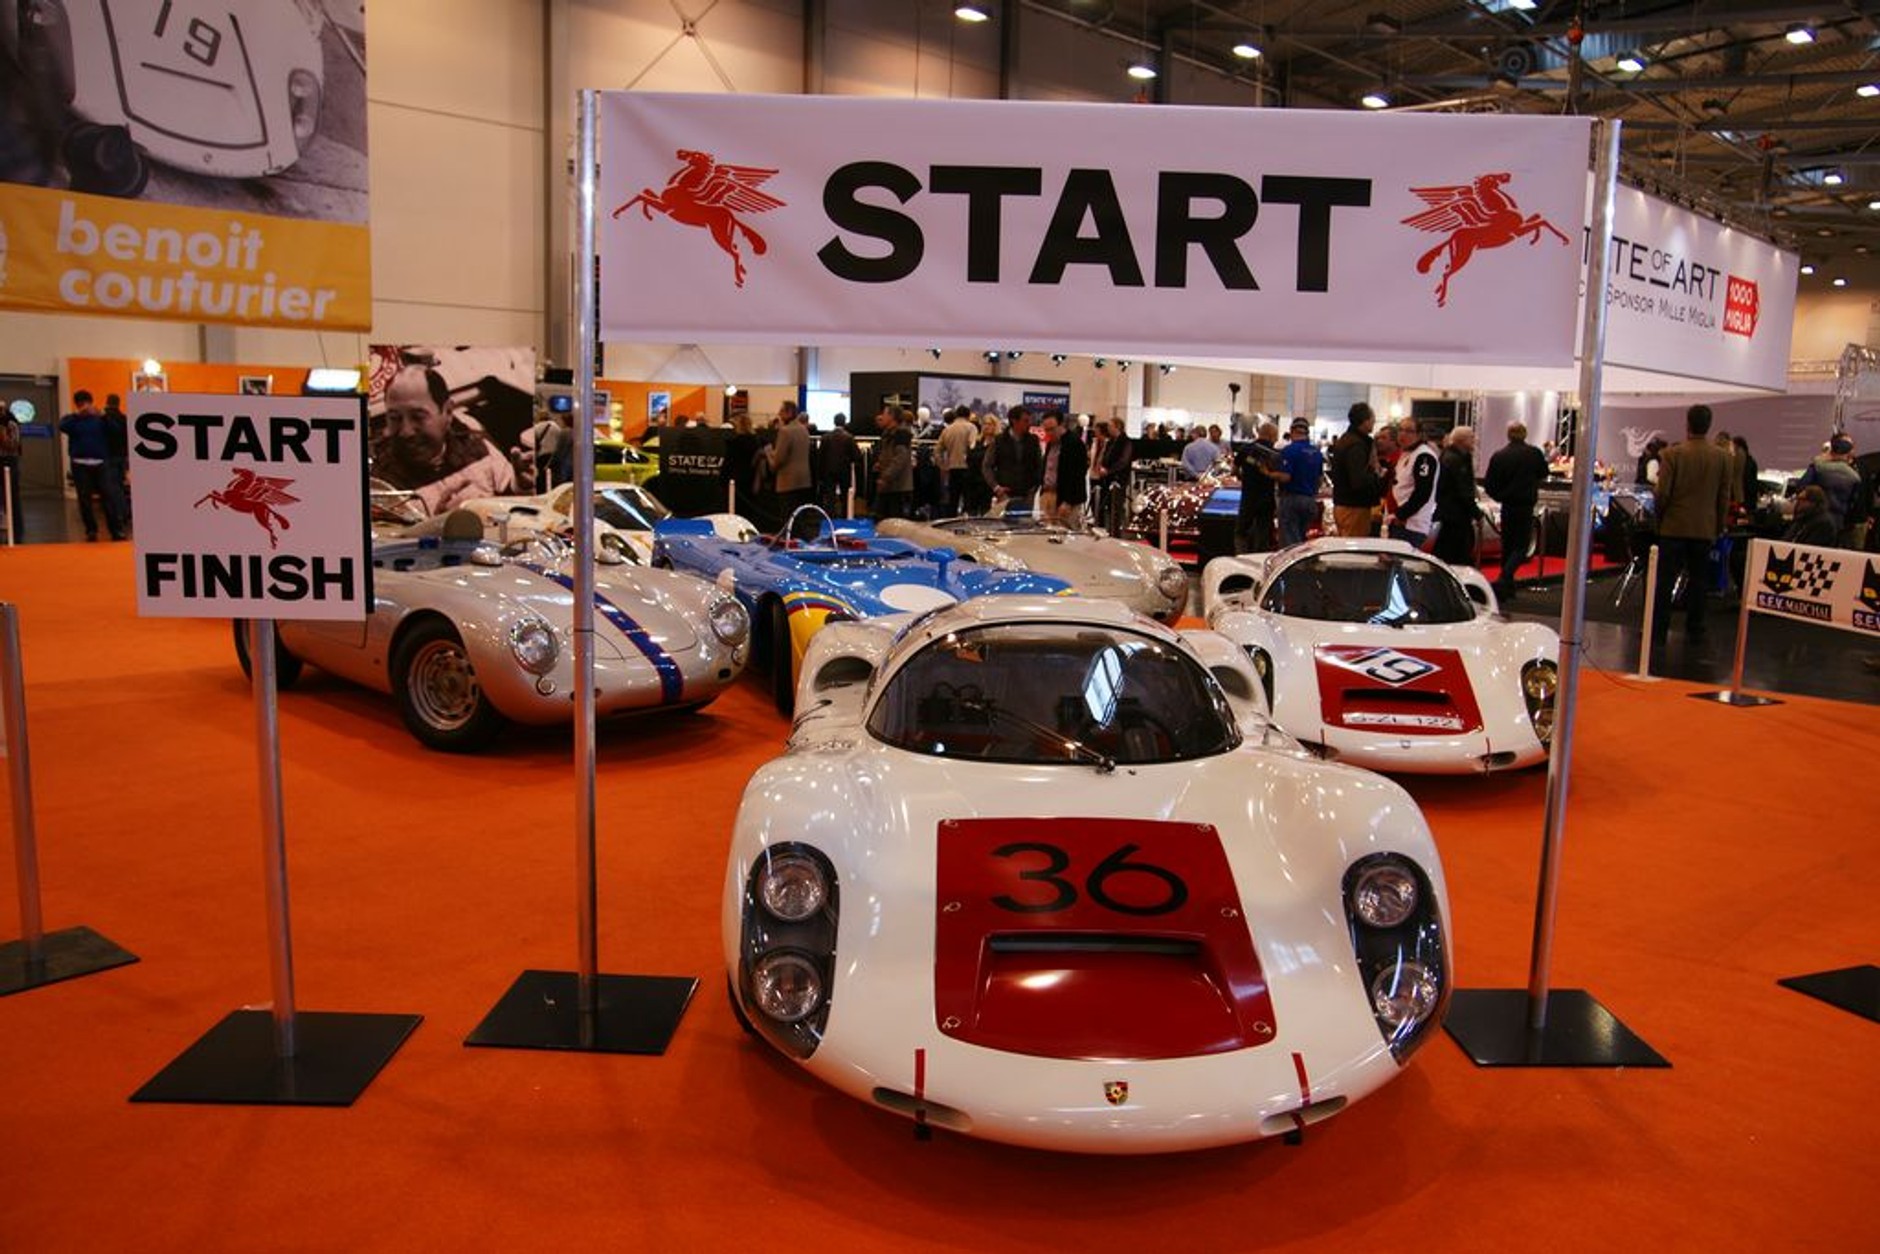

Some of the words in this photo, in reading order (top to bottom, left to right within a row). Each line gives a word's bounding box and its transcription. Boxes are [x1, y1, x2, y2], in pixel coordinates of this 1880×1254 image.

[153, 0, 222, 67] 19
[57, 199, 264, 270] benoit
[816, 160, 1373, 293] START
[58, 268, 337, 321] couturier
[1652, 249, 1673, 271] OF
[1671, 260, 1721, 302] ART
[1729, 281, 1753, 306] 1000
[134, 412, 355, 463] START
[668, 454, 706, 467] STATE
[1419, 463, 1430, 477] 3
[145, 552, 355, 601] FINISH
[1350, 648, 1434, 683] 19
[990, 841, 1189, 916] 36
